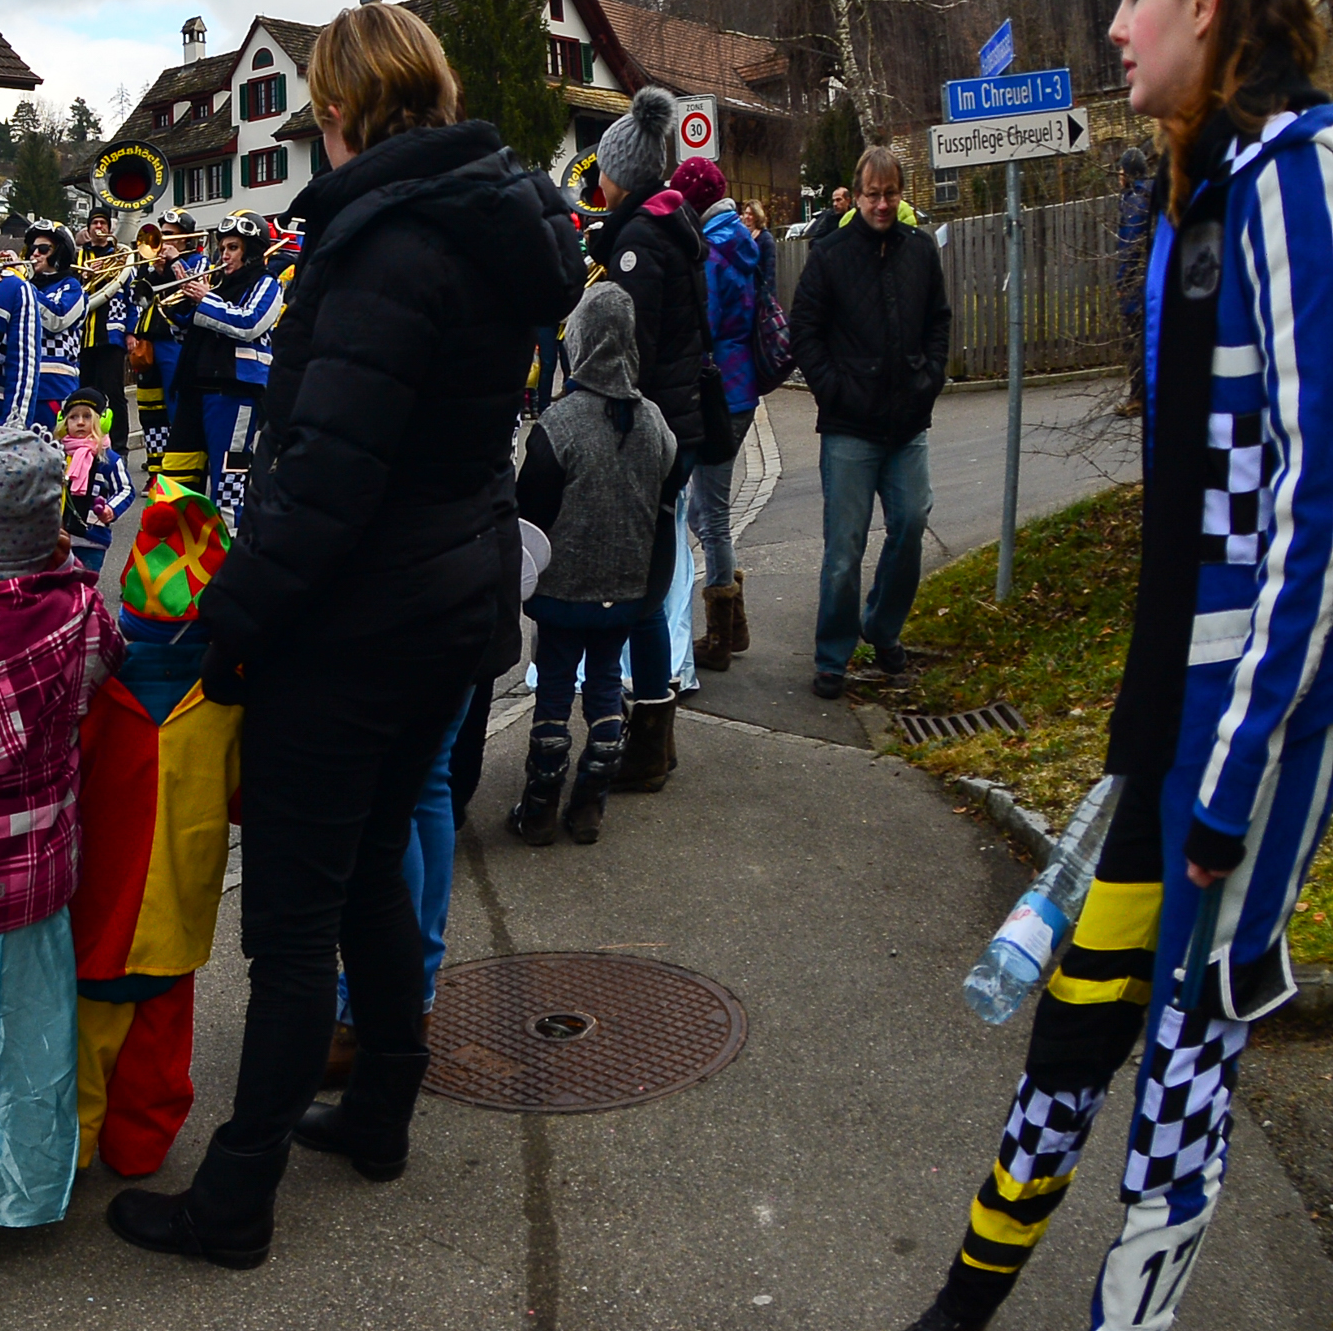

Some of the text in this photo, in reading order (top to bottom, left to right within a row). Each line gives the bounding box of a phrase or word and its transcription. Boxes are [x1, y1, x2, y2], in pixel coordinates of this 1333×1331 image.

[686, 103, 704, 112] ZONE
[957, 86, 976, 111] Im
[981, 79, 1033, 108] Chreuel
[690, 123, 703, 137] 30
[937, 120, 1064, 157] Fusspflege Chreuel 3
[95, 145, 164, 186] Vollgashöckler
[567, 153, 598, 188] Vollga
[99, 189, 155, 210] Hedingen
[575, 200, 607, 212] Hedi
[1132, 1224, 1207, 1326] 17
